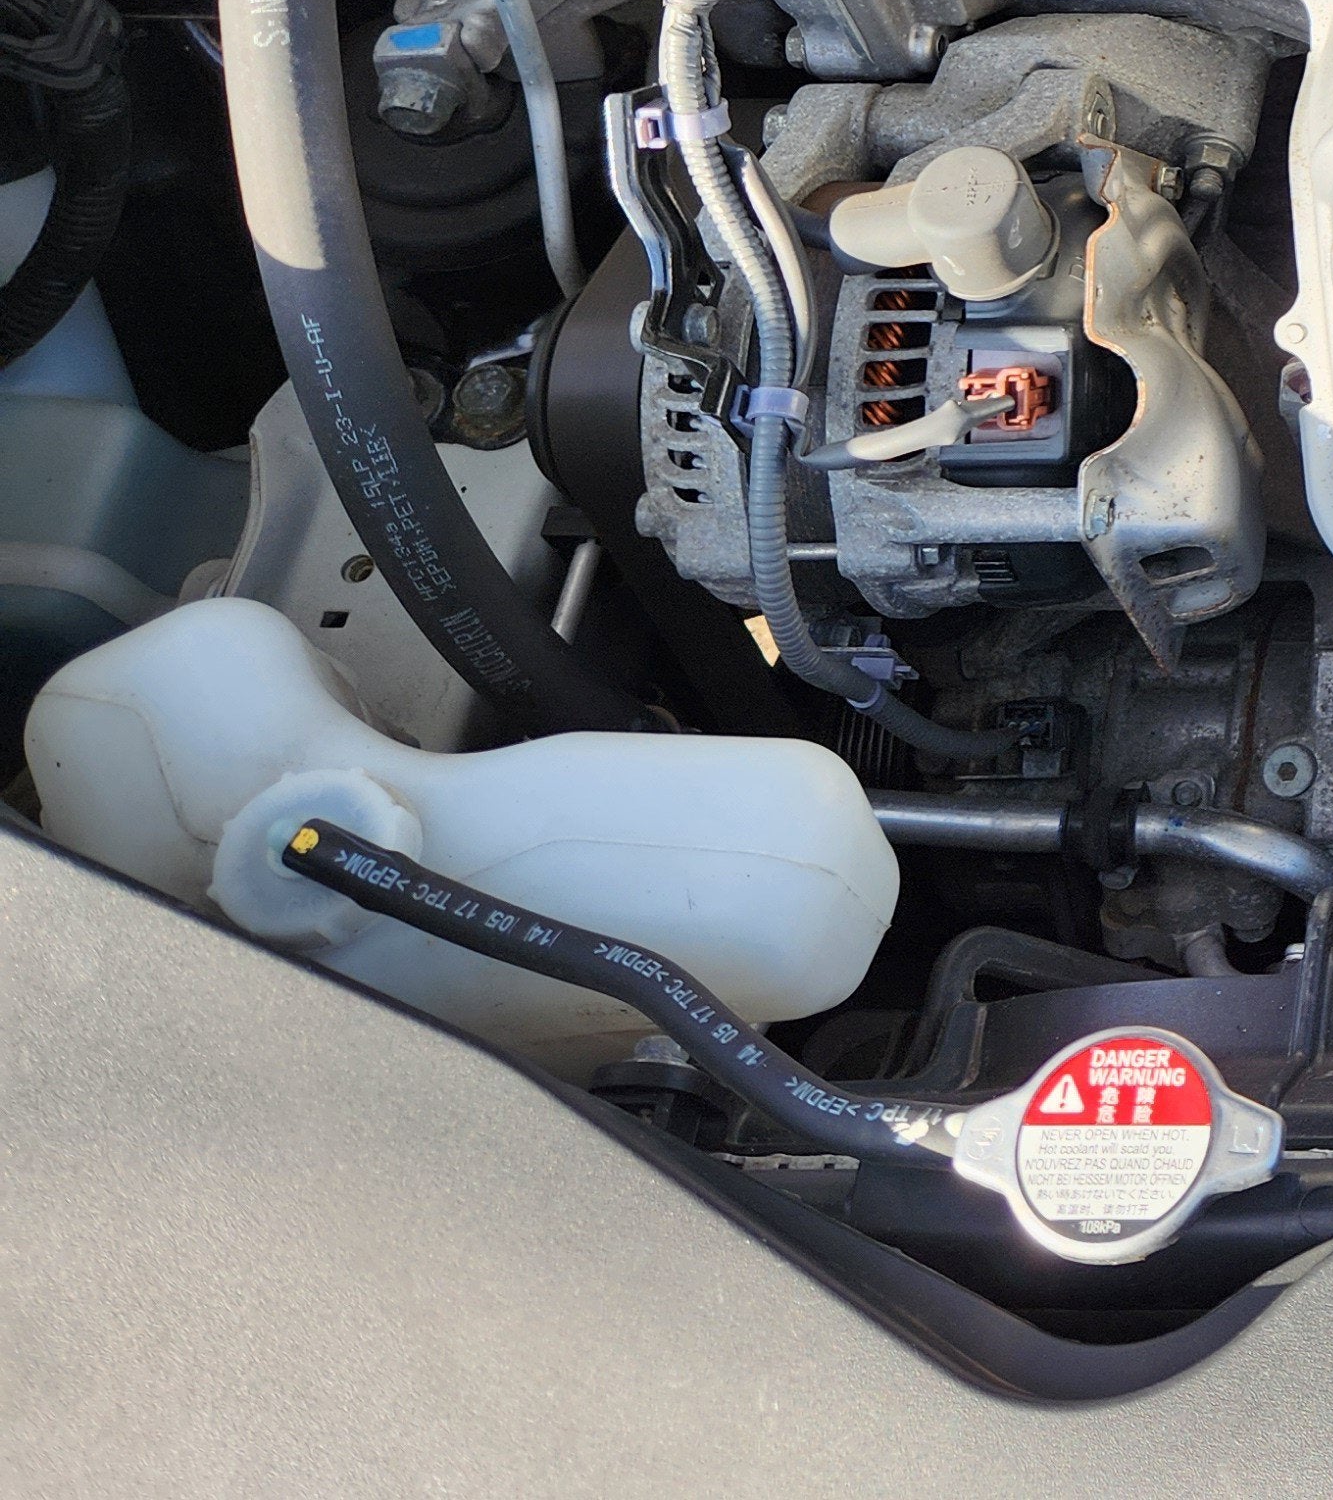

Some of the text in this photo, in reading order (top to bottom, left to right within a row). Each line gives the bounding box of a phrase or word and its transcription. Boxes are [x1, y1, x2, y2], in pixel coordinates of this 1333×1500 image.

[334, 849, 411, 892] >EPDM<
[412, 883, 452, 910] TPC
[454, 900, 480, 920] 17
[593, 942, 670, 983] >EPDM<
[664, 978, 698, 1010] TPC
[690, 1005, 716, 1024] 17
[711, 1021, 739, 1044] 05
[1090, 1049, 1171, 1067] DANGER
[1089, 1068, 1186, 1087] WARNUNG
[784, 1076, 862, 1116] >EPDM<
[865, 1103, 911, 1122] TPC
[1041, 1129, 1190, 1141] NEVER OPEN WHEN HOT.
[1039, 1144, 1058, 1154] Hot
[1060, 1143, 1099, 1155] coolant
[1101, 1143, 1119, 1154] will
[1120, 1143, 1150, 1155] scald
[1025, 1158, 1194, 1171] N'OUVREZ PAS QUAND CHAUD
[1027, 1173, 1054, 1186] NICHT
[1056, 1173, 1072, 1186] BEI
[1073, 1173, 1114, 1186] HEISSEM
[1115, 1173, 1147, 1186] MOTOR
